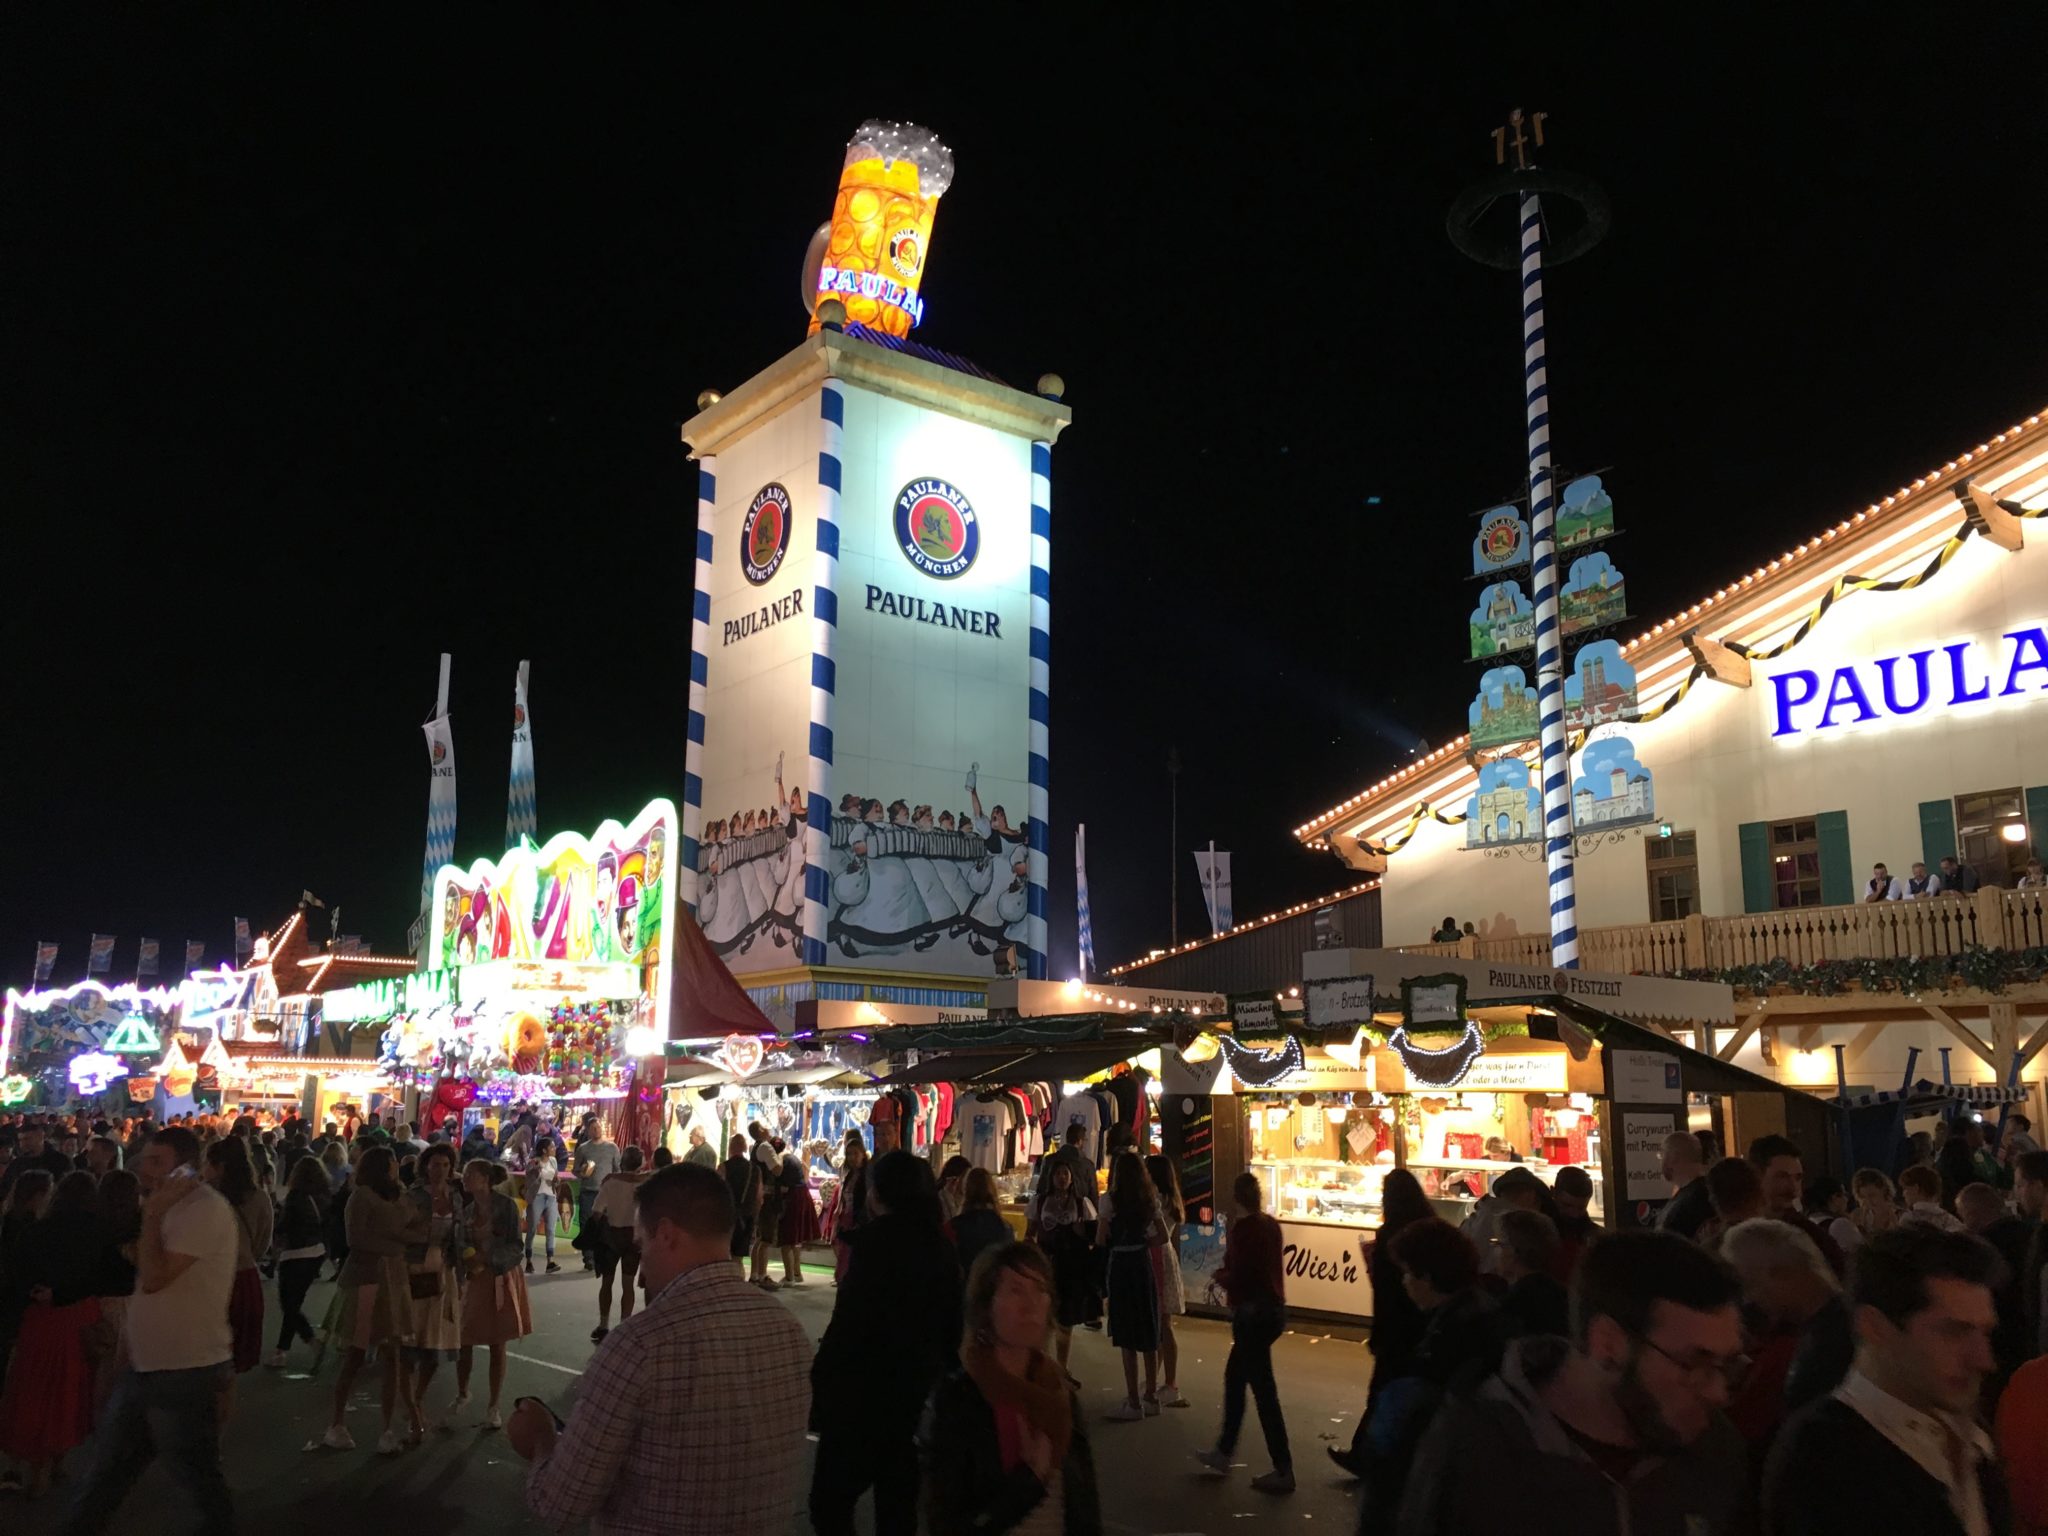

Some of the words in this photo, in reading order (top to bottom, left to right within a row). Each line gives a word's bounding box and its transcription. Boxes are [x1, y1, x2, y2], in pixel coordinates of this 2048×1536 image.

[744, 487, 788, 533] PAULANER
[900, 480, 974, 526] PAULANER
[745, 547, 784, 580] MÜNCHEN
[905, 542, 969, 574] MÜNCHEN
[722, 588, 804, 647] PAULANER
[864, 584, 1003, 640] PAULANER
[1768, 627, 2048, 738] PAULA
[1488, 969, 1552, 992] PAULANER
[1570, 977, 1623, 997] FESTZELT
[1237, 1003, 1273, 1015] Münchne
[1626, 1123, 1673, 1136] Currywurst
[1627, 1141, 1640, 1152] mit
